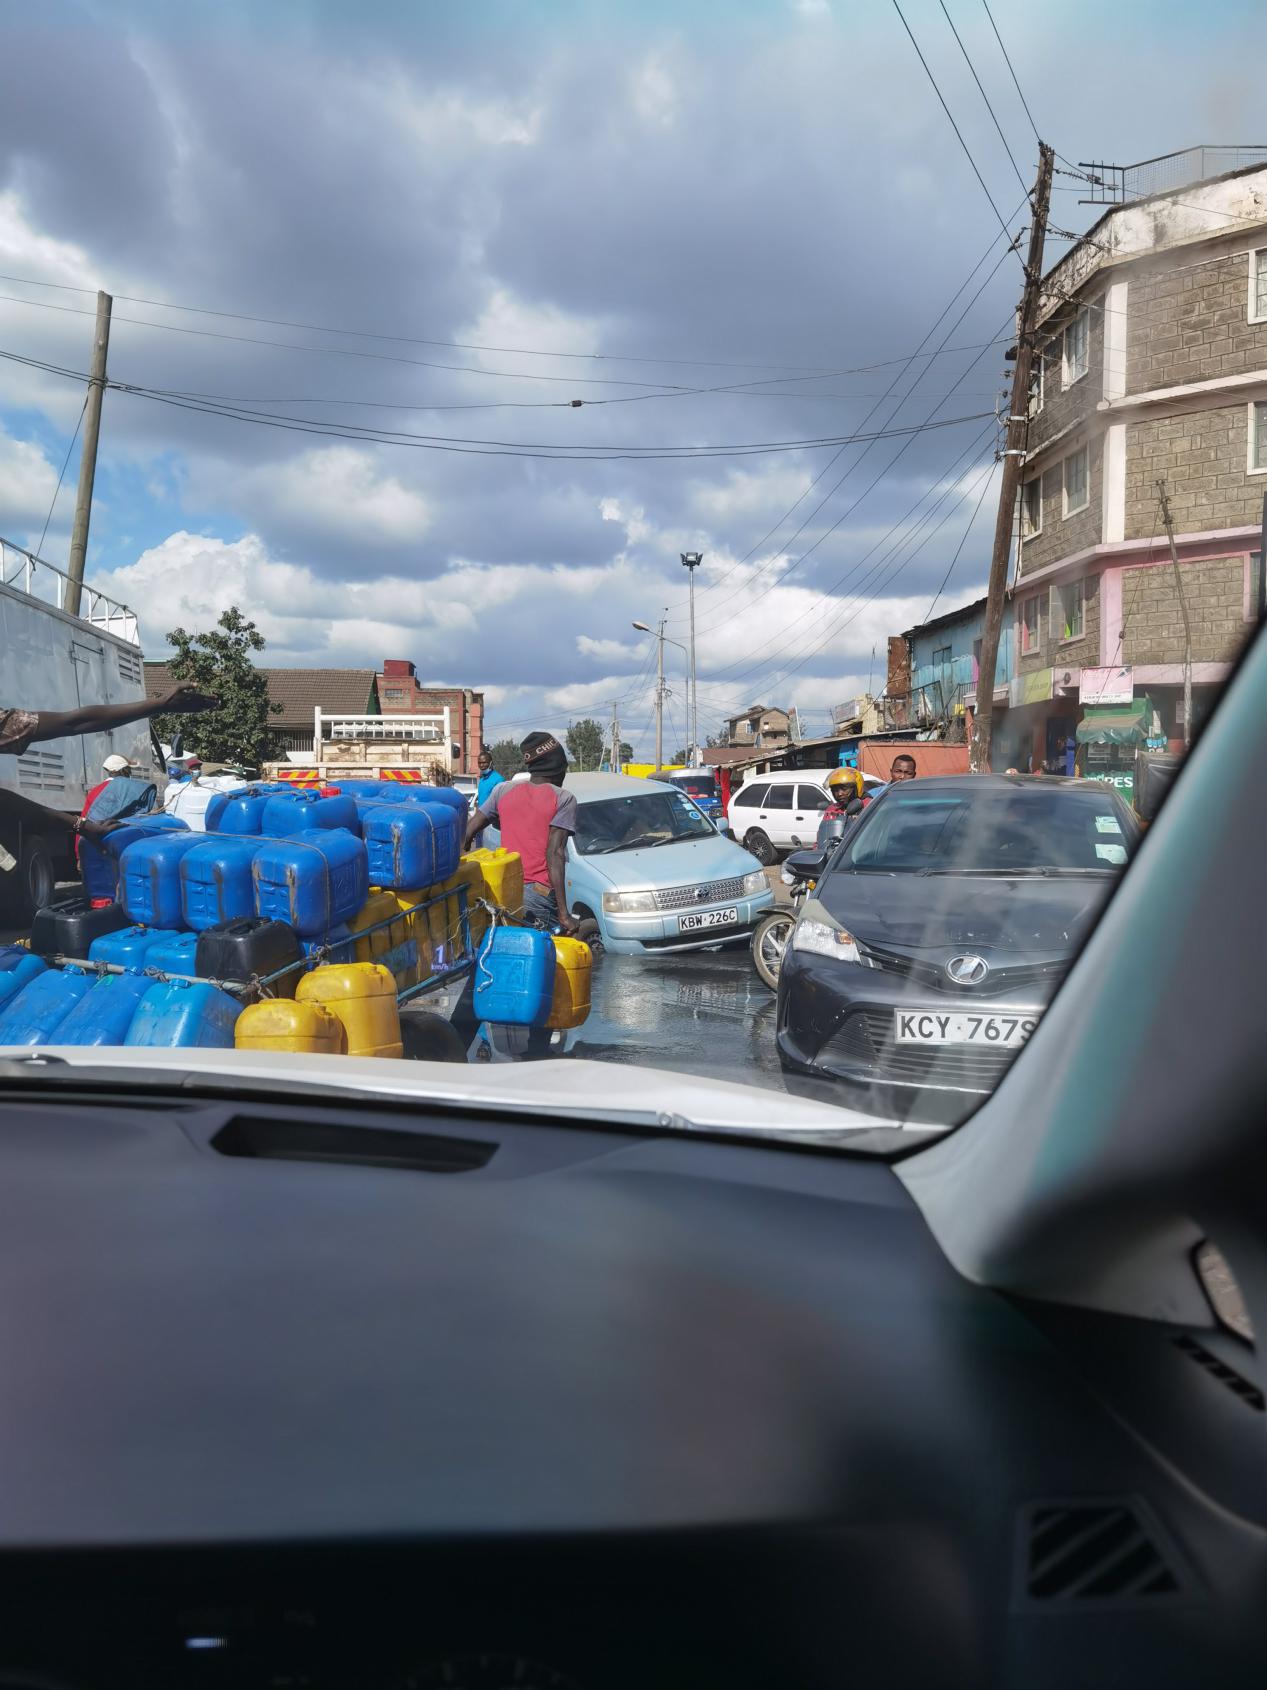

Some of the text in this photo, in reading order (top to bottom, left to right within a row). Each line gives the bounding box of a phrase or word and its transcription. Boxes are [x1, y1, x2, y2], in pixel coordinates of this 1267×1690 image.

[681, 910, 735, 929] KBW 226C
[435, 944, 443, 963] 1
[901, 1015, 950, 1038] KCY
